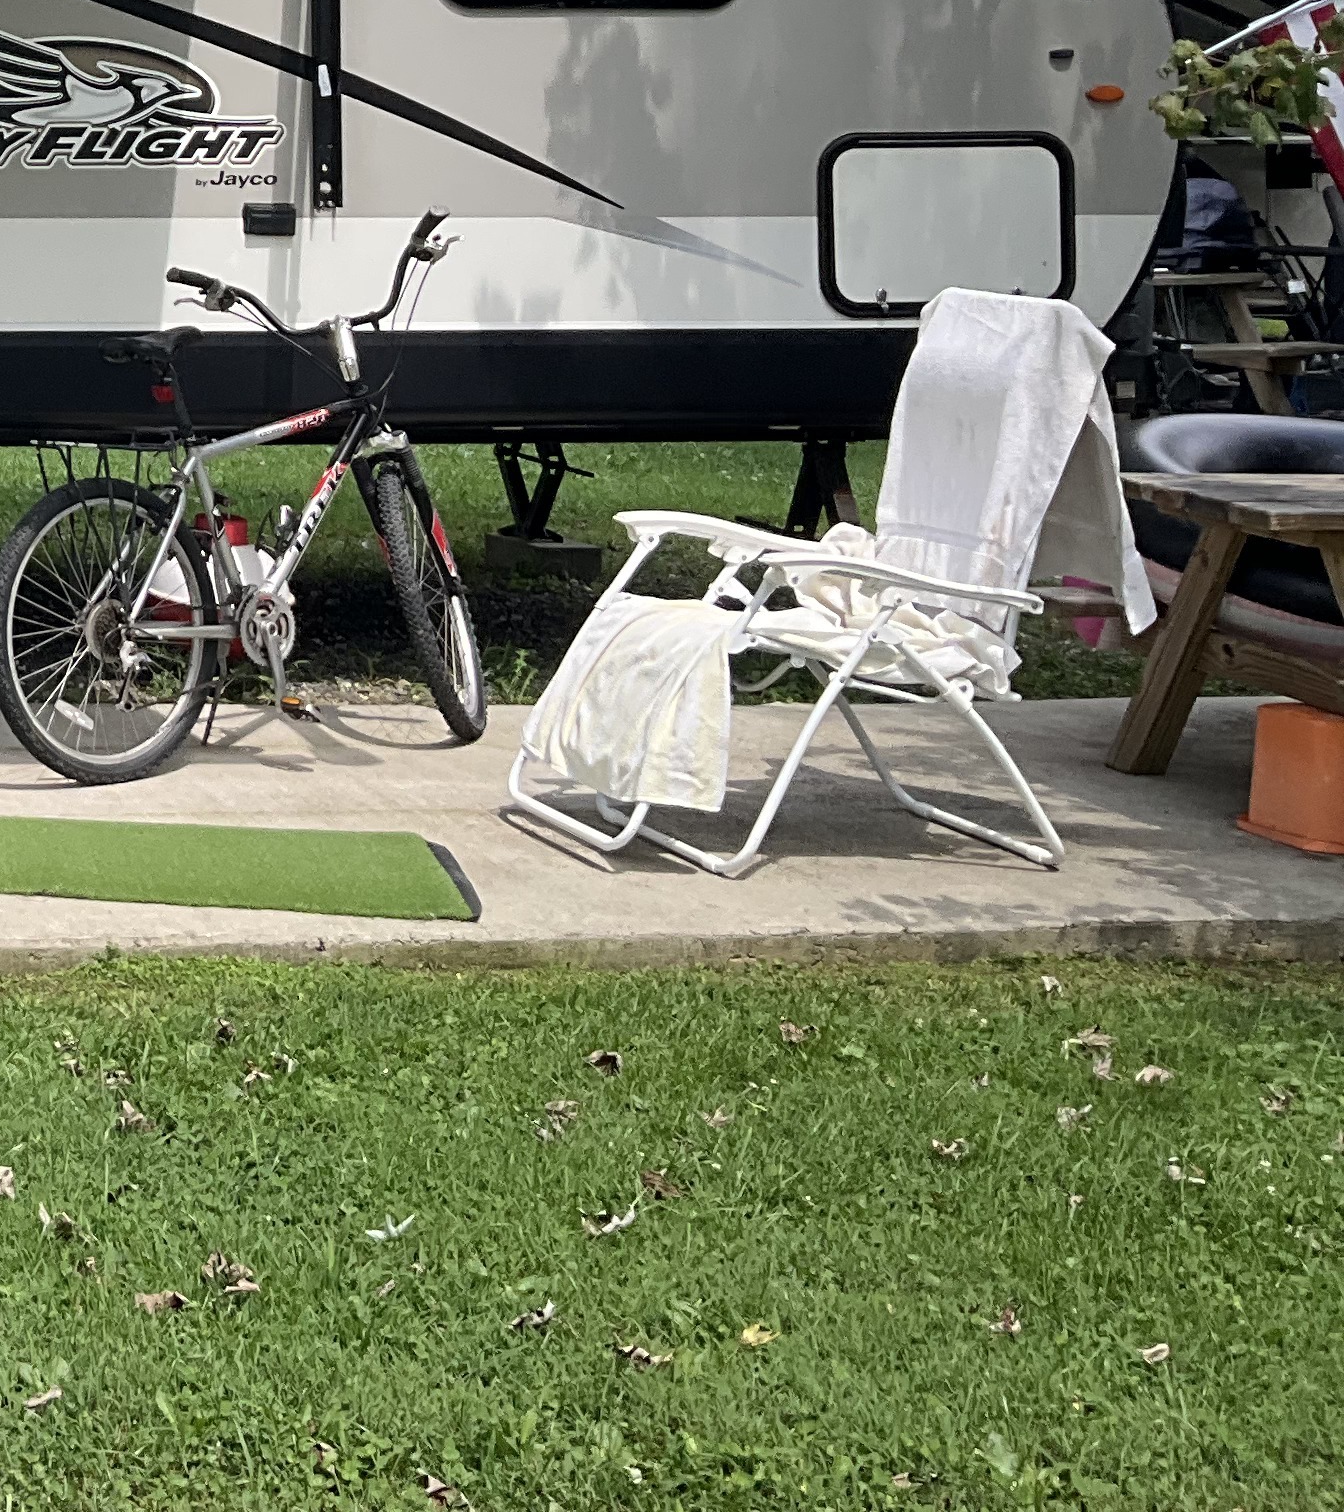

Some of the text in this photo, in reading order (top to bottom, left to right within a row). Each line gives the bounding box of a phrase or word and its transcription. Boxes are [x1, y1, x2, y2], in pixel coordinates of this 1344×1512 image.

[25, 124, 282, 166] FLIGHT
[196, 170, 278, 188] by Jayco
[291, 464, 347, 553] TREK
